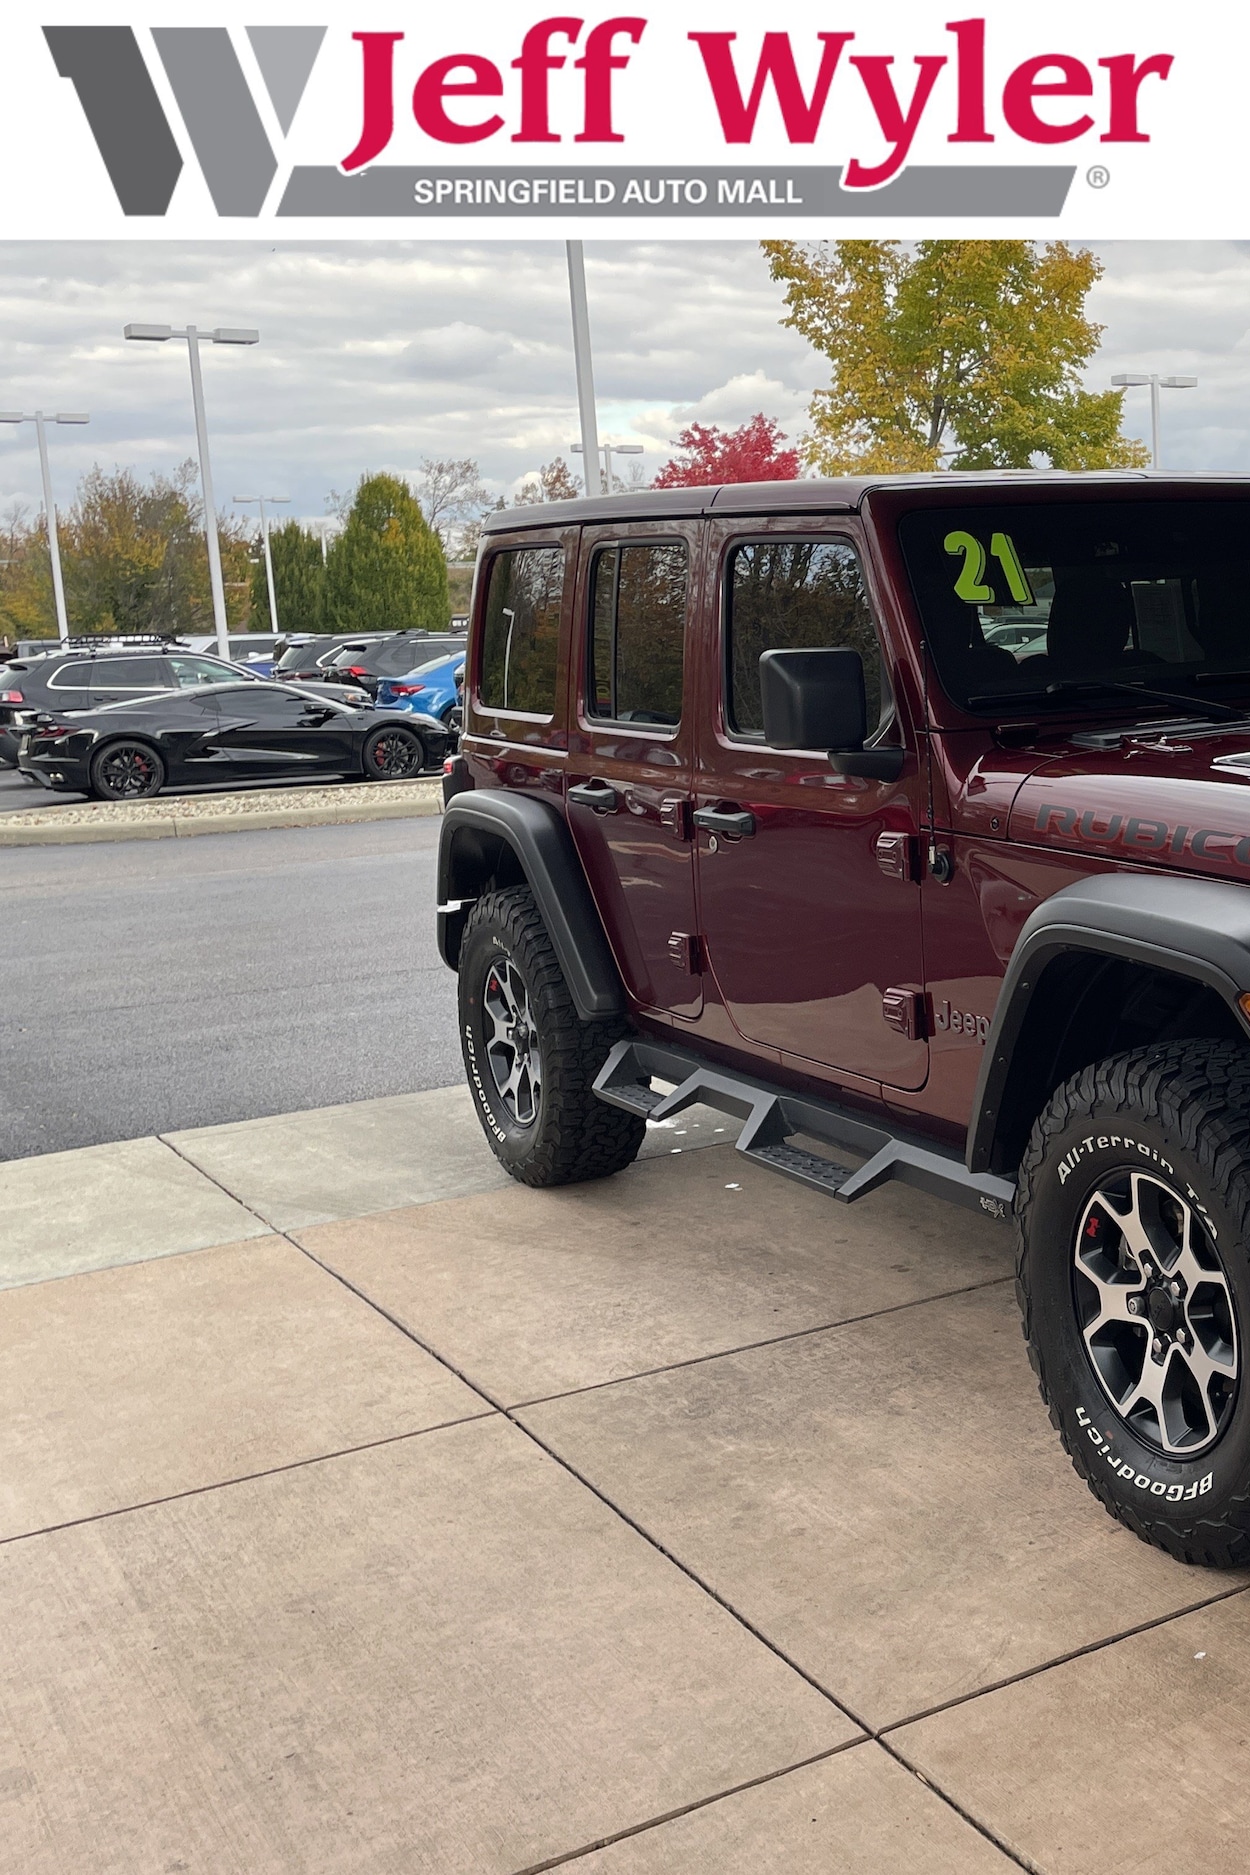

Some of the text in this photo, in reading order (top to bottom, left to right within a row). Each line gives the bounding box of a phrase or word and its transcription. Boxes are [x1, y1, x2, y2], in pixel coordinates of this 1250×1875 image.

[944, 530, 1034, 605] 21
[935, 1000, 991, 1046] Jeep
[465, 1024, 507, 1143] BFGoodrich
[1056, 1135, 1219, 1240] All-Terrain T/A
[1075, 1406, 1214, 1502] BFGoodrich
